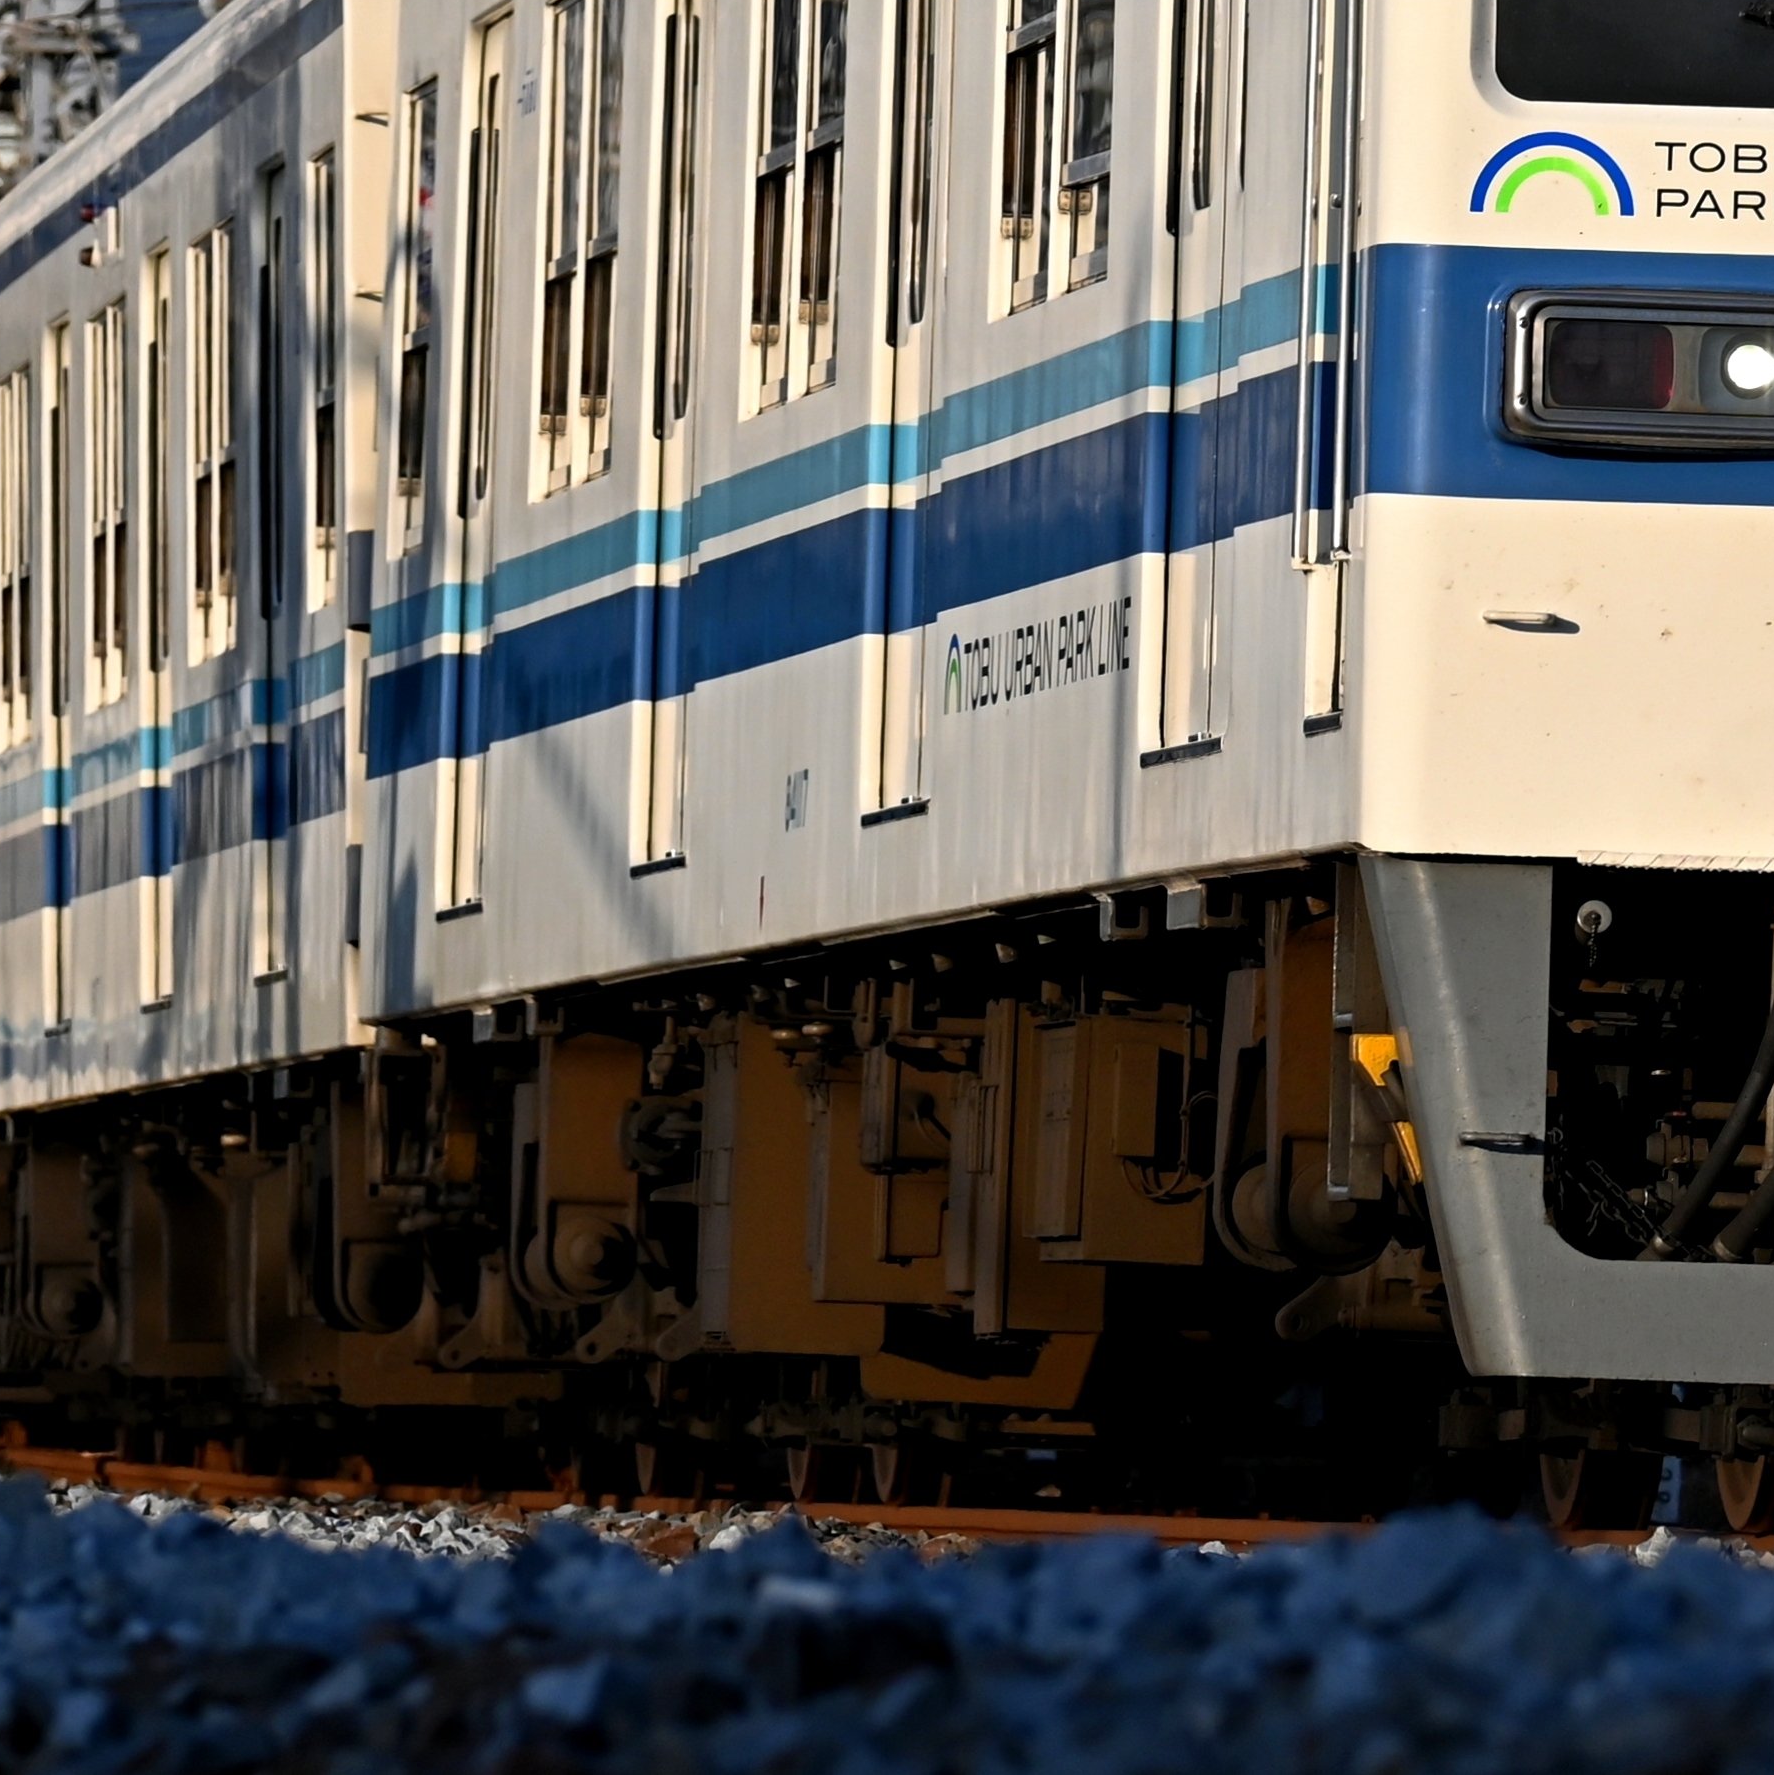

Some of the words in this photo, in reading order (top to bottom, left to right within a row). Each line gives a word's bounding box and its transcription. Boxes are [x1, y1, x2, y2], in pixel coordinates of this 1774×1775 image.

[963, 635, 1002, 712] TOBU
[1004, 619, 1055, 702] URBAN
[1056, 606, 1097, 687] PARK
[1097, 595, 1132, 676] LINE
